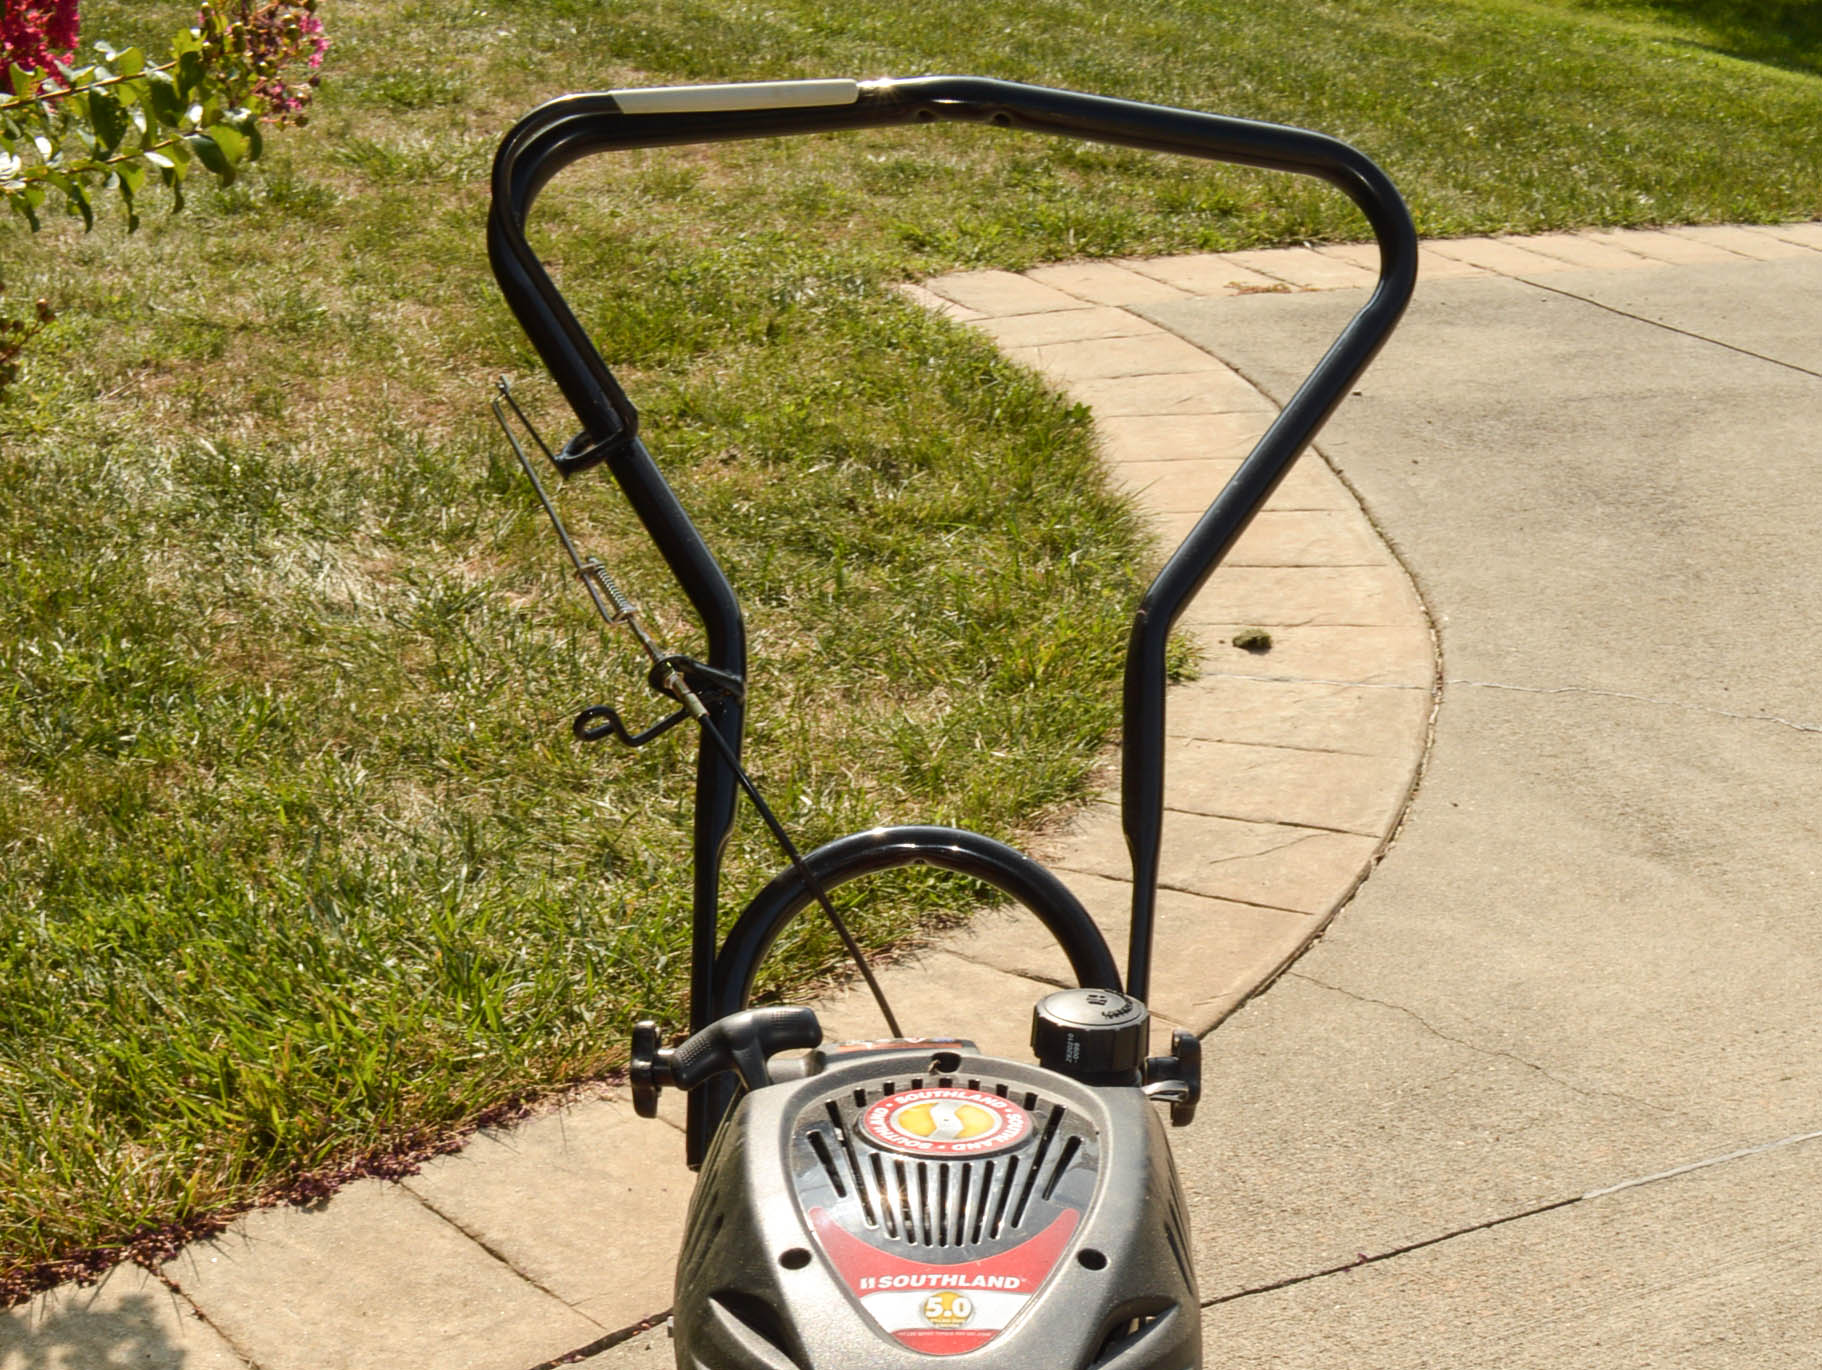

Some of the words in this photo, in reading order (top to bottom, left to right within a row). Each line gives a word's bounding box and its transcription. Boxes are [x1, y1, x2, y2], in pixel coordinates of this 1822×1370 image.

[894, 1091, 1008, 1111] SOUTHLAND
[877, 1274, 1021, 1289] SOUTHLAND
[925, 1297, 972, 1318] 5.0
